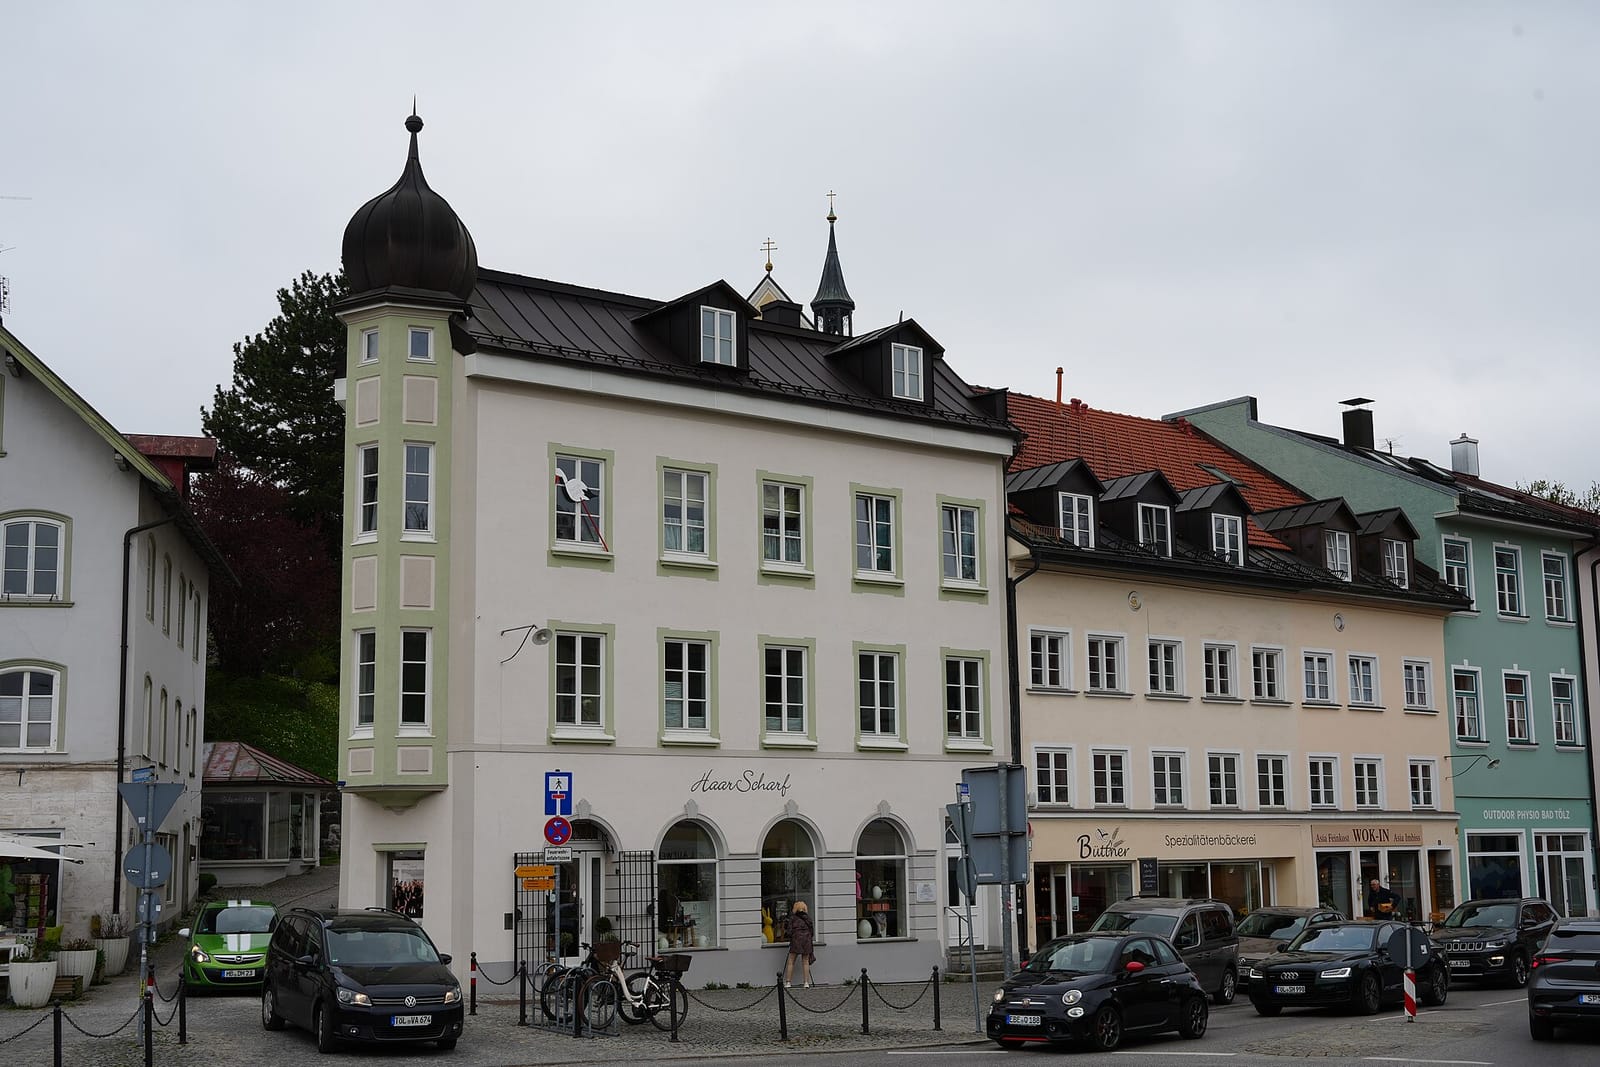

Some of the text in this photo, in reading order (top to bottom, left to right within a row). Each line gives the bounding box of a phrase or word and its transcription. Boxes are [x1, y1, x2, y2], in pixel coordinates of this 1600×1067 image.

[1483, 807, 1570, 820] OUTDOOR PHYSIO BAD TÖLZ
[1165, 833, 1257, 849] Spezialitätenbäckerei
[1315, 833, 1328, 843] Asia
[1352, 828, 1390, 842] WOK-IN
[1393, 833, 1404, 842] Asia
[1076, 834, 1130, 859] Büttner
